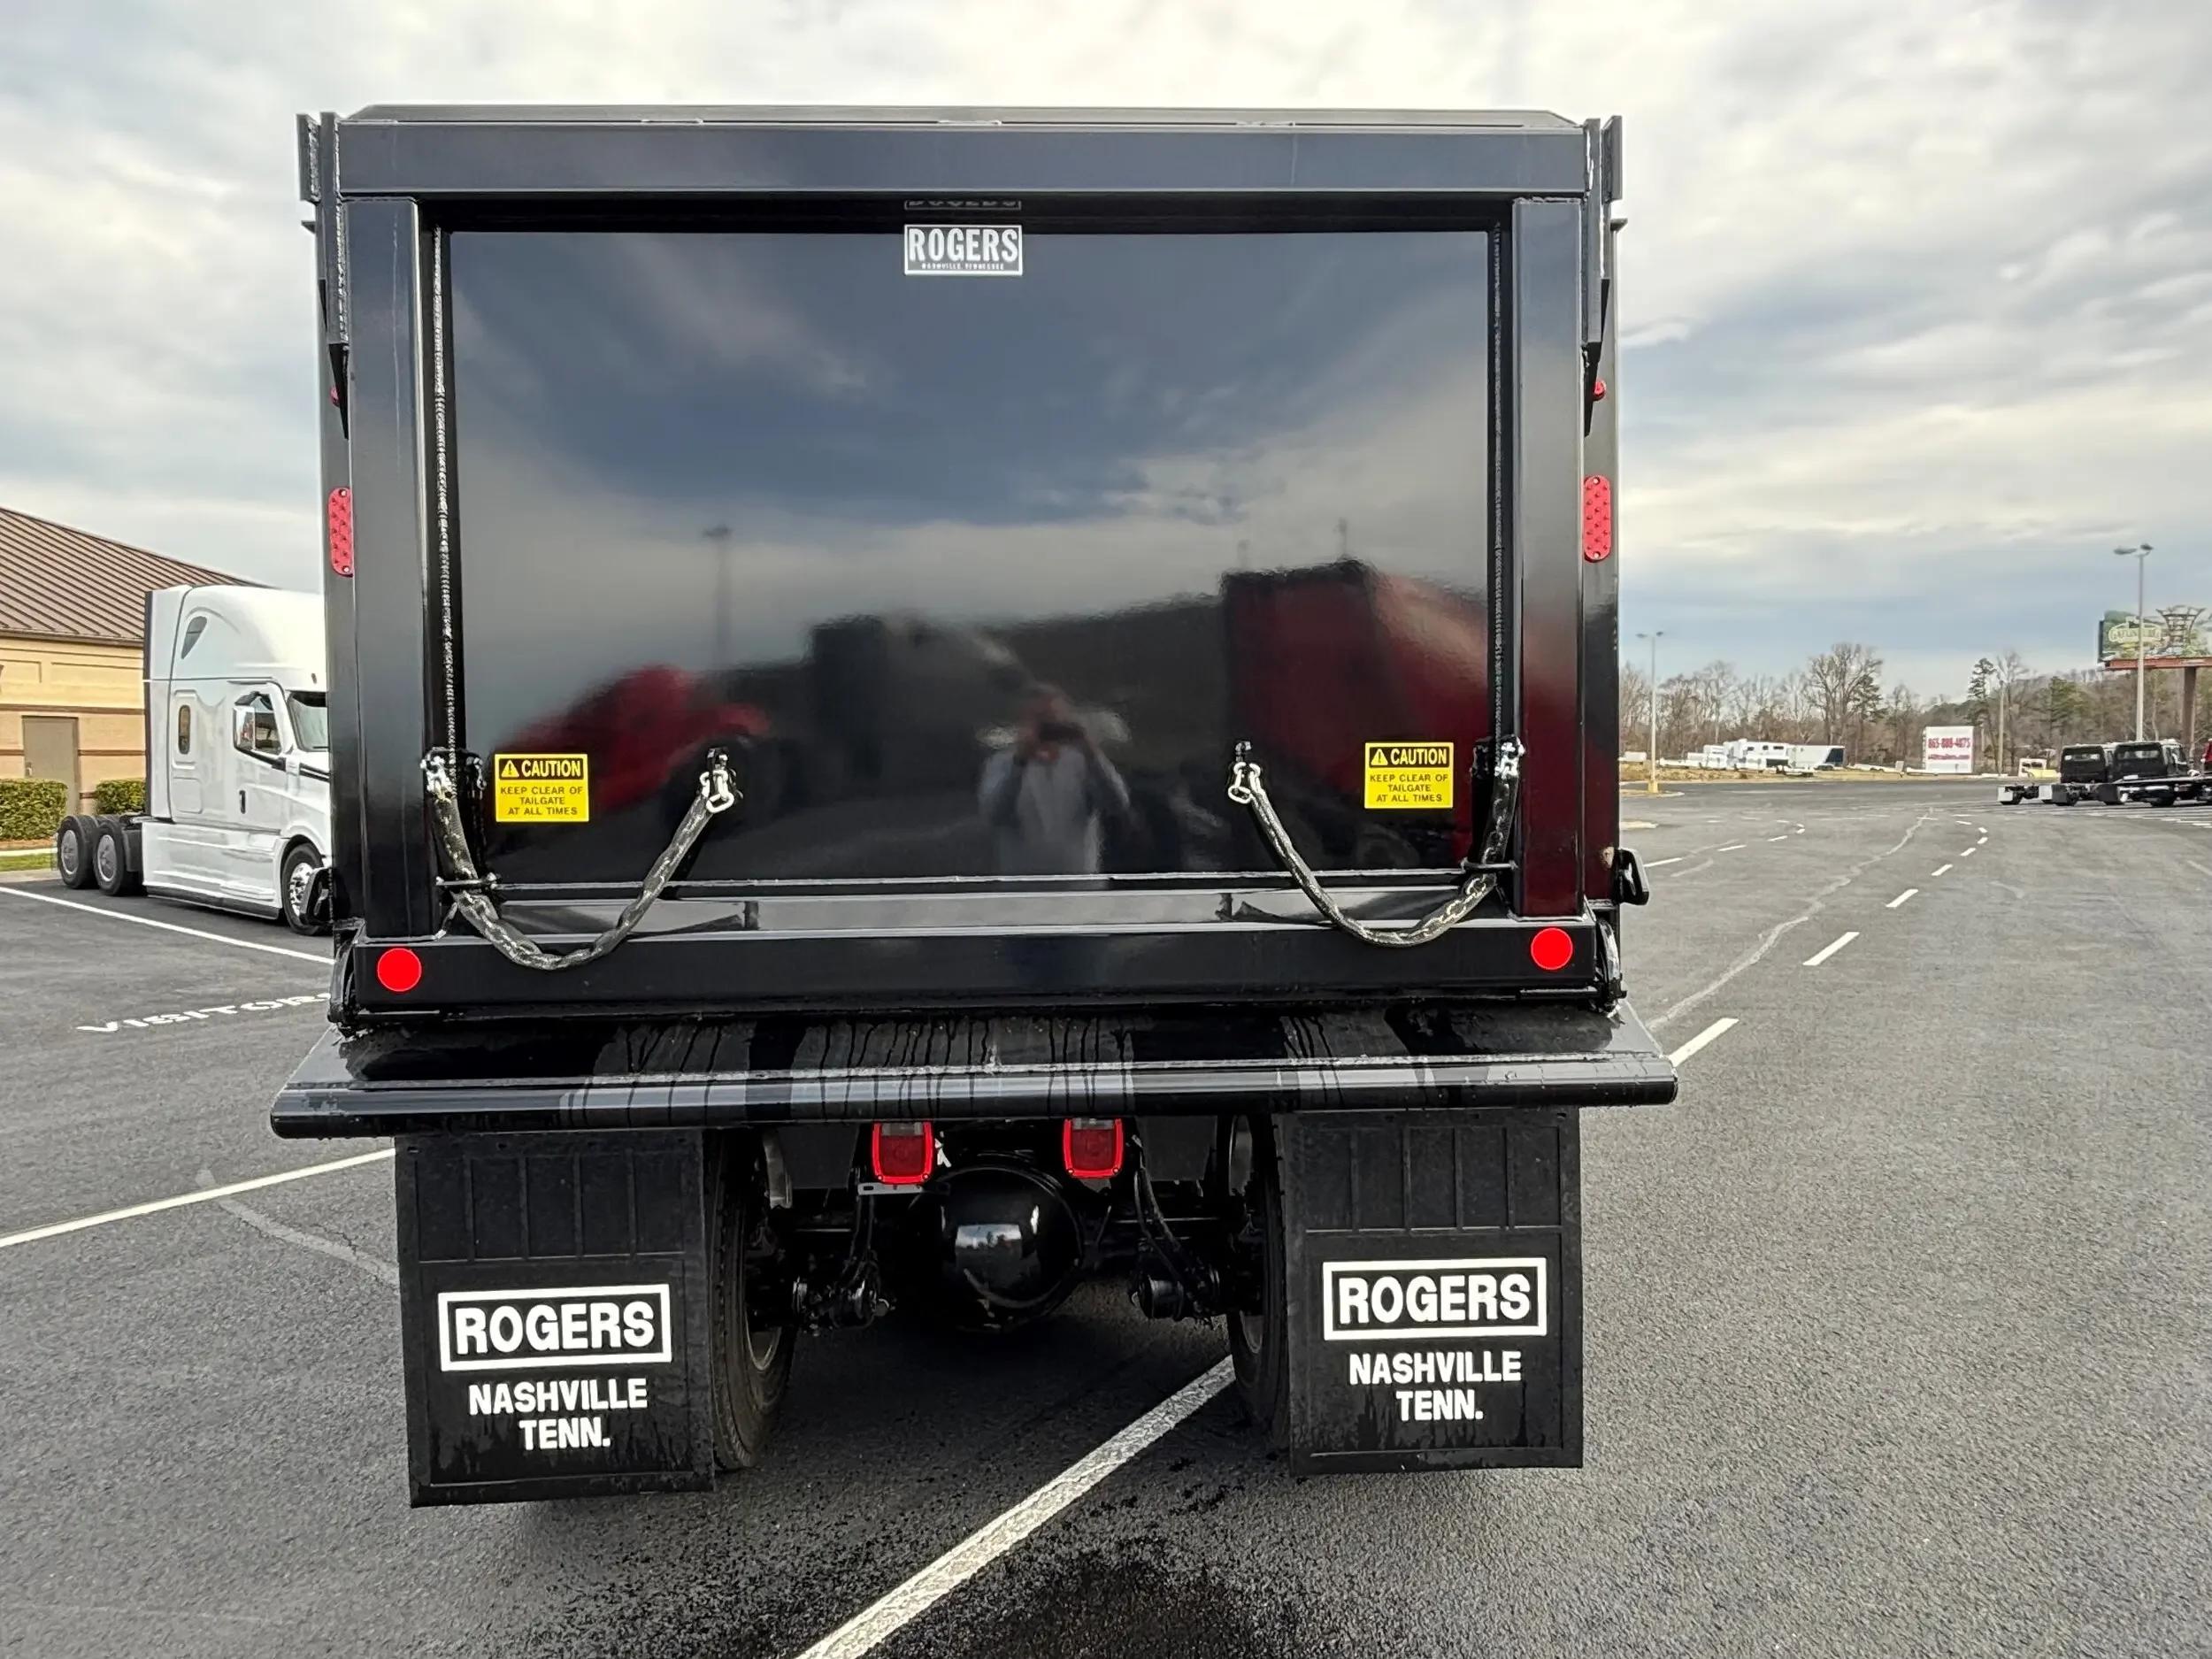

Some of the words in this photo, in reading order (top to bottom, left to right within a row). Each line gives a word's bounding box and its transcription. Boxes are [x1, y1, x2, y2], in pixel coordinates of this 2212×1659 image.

[909, 228, 1018, 262] ROGERS
[521, 759, 581, 778] CAUTION
[1390, 748, 1447, 765] CAUTION
[500, 786, 527, 795] KEEP
[531, 786, 565, 795] CLEAR
[569, 786, 583, 795] OF
[1370, 773, 1395, 783] KEEP
[1399, 773, 1432, 783] CLEAR
[1435, 773, 1448, 782] OF
[520, 796, 565, 805] TAILGATE
[1376, 794, 1387, 803] AT
[1391, 794, 1409, 803] ALL
[1339, 1274, 1531, 1325] ROGERS
[455, 1301, 655, 1355] ROGERS
[1349, 1350, 1521, 1386] NASHVILLE
[468, 1378, 648, 1416] NASHVILLE
[1395, 1389, 1484, 1422] TENN.
[518, 1417, 611, 1451] TENN.
